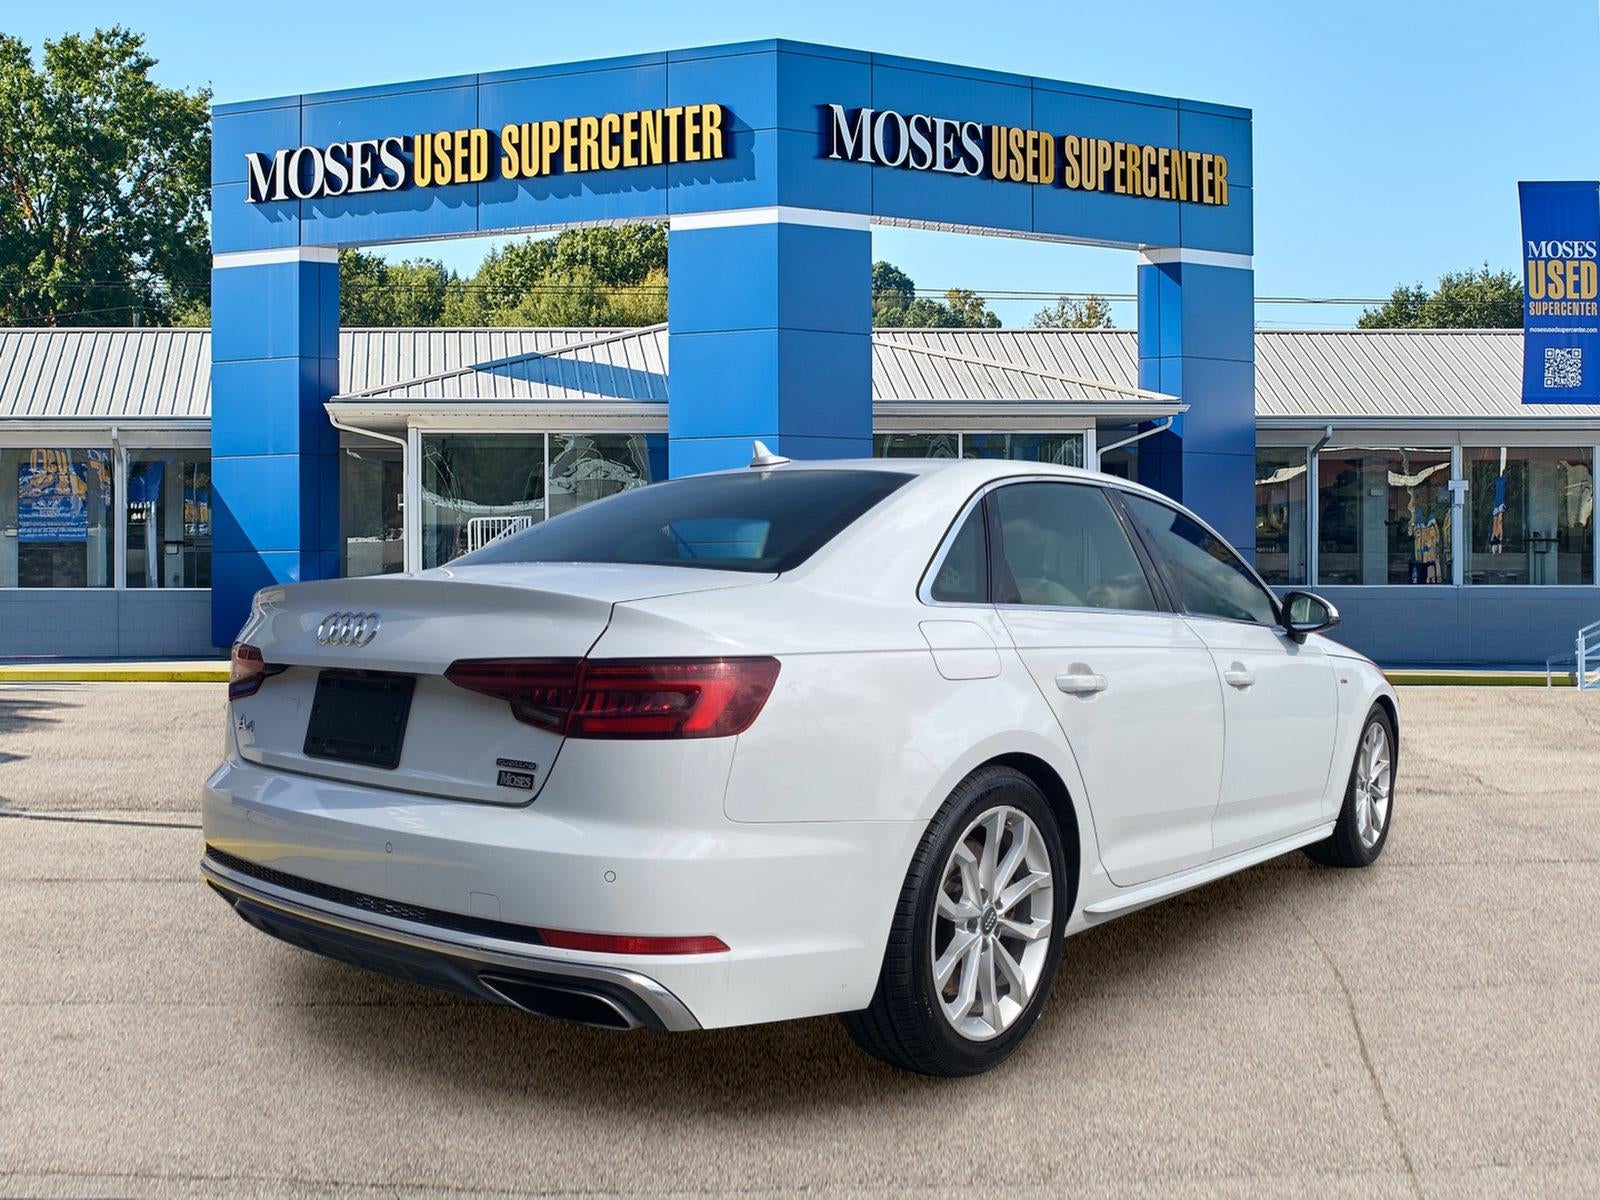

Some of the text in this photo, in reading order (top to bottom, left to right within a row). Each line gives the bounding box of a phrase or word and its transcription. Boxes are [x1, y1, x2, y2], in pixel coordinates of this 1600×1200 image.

[244, 103, 724, 203] MOSES USED SUPERCENTER
[828, 103, 1230, 207] MOSES USED SUPERCENTER
[1527, 240, 1597, 259] MOSES
[1527, 260, 1598, 300] USED
[1528, 301, 1598, 317] SUPERCENTER
